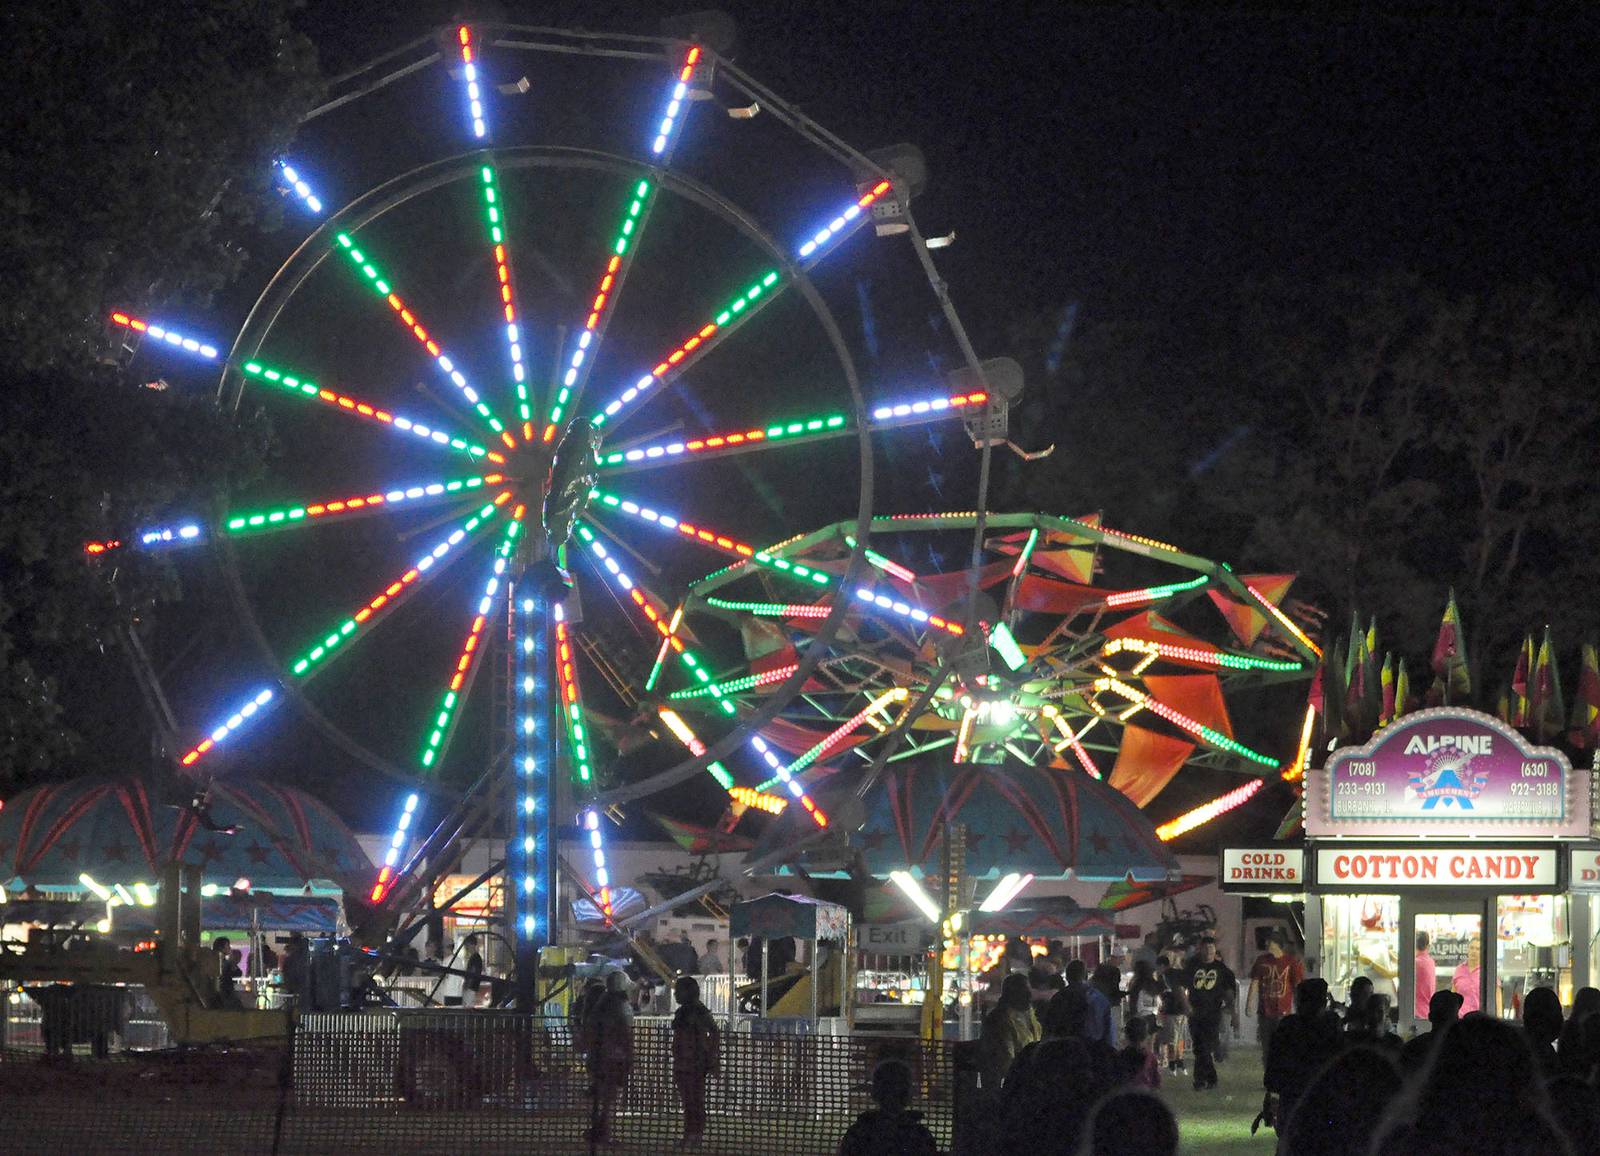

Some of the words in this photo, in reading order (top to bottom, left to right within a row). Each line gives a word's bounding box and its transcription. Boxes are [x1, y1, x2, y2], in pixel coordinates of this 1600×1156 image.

[1403, 735, 1492, 755] ALPINE
[1348, 761, 1376, 777] (708)
[1521, 762, 1547, 778] (630)
[1337, 782, 1385, 796] 233-9131
[1510, 783, 1558, 796] 922-3188
[1241, 853, 1285, 865] COLD
[1231, 867, 1296, 880] DRINKS
[1333, 855, 1438, 879] COTTON
[1449, 855, 1540, 879] CANDY
[869, 927, 907, 944] Exit
[1428, 943, 1469, 955] ALPINE
